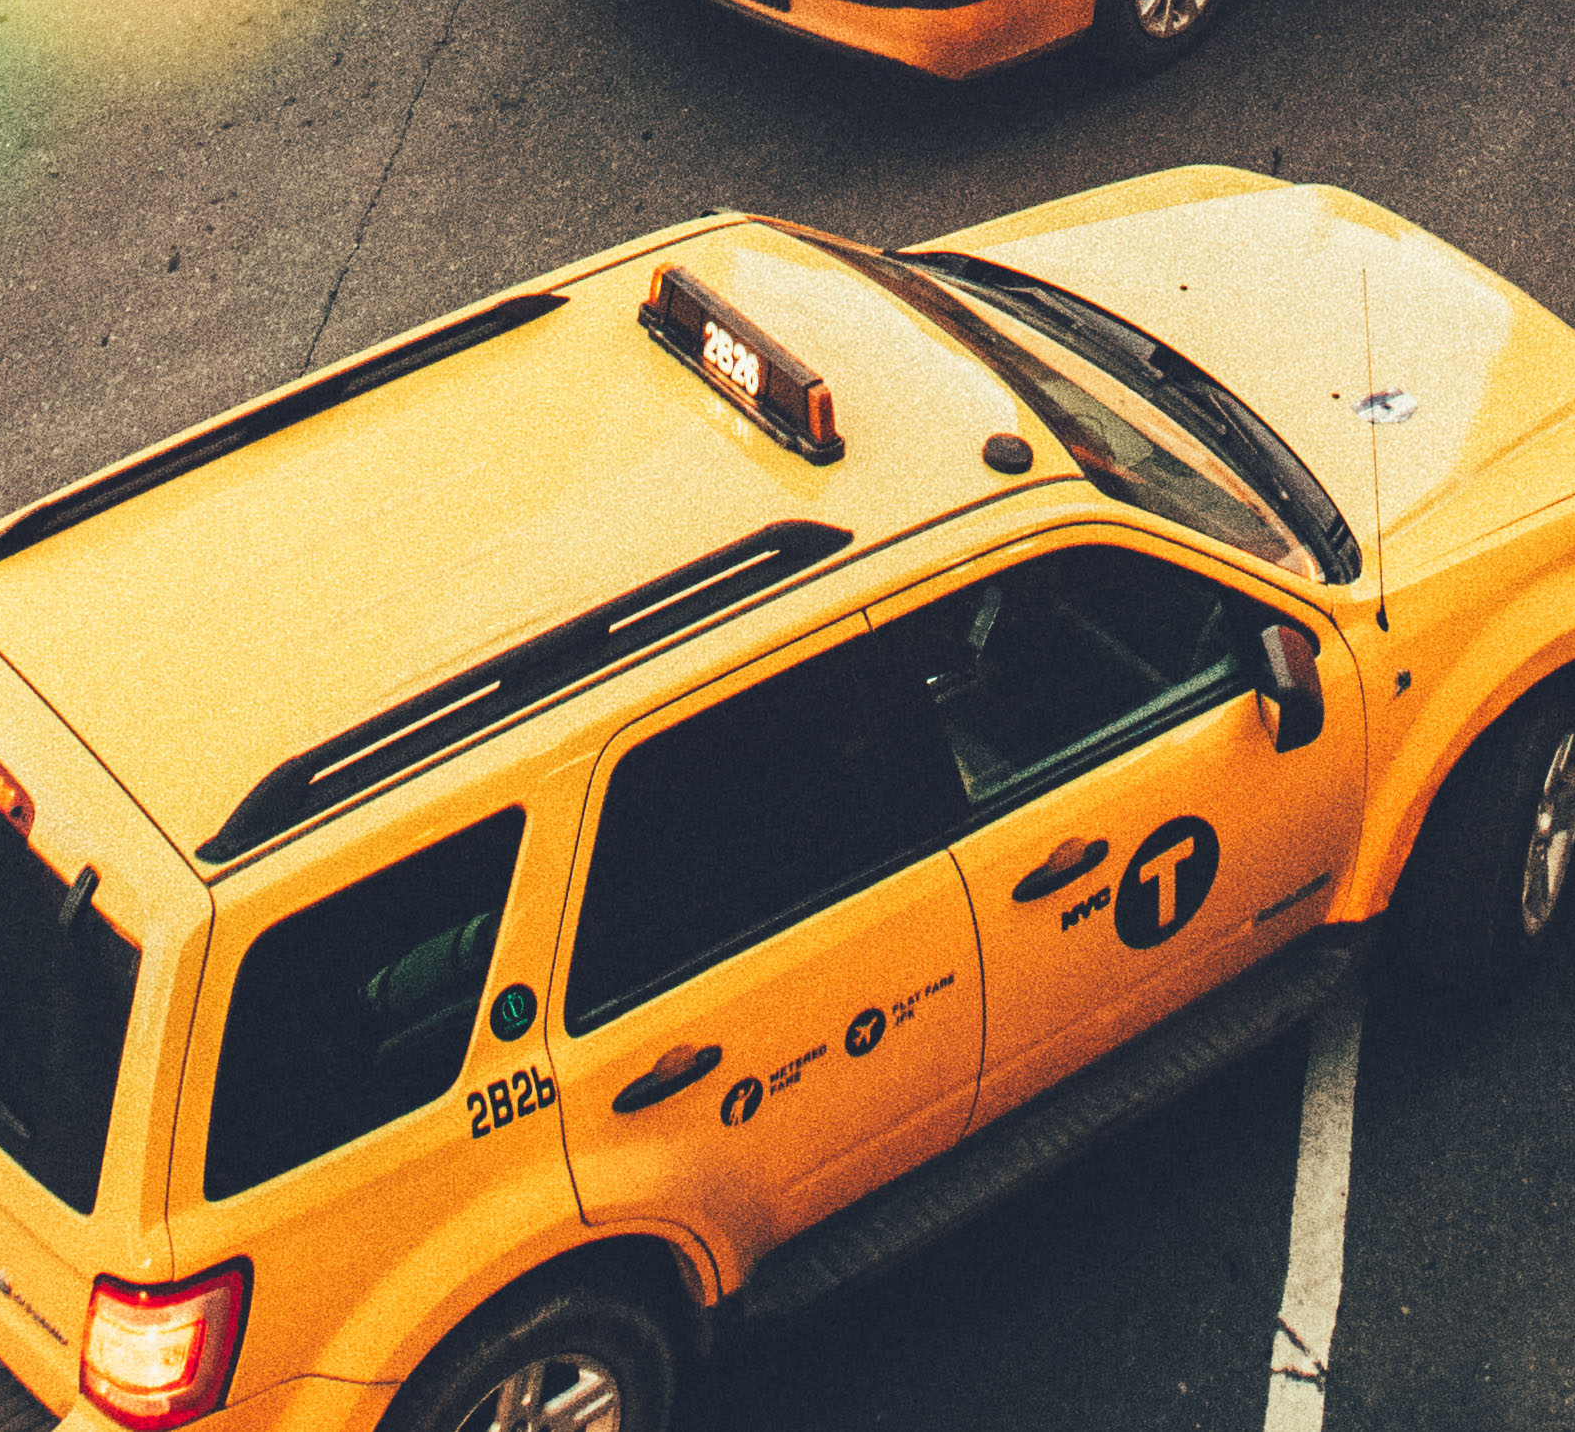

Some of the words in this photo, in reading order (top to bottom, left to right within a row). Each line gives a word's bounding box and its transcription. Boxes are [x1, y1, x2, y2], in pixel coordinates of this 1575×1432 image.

[704, 321, 759, 397] 2B26
[1061, 885, 1112, 934] NYC
[1139, 835, 1195, 929] T
[892, 992, 921, 1016] FLAT
[924, 973, 955, 999] FARE
[769, 1043, 827, 1083] METERED
[769, 1070, 801, 1097] FARE
